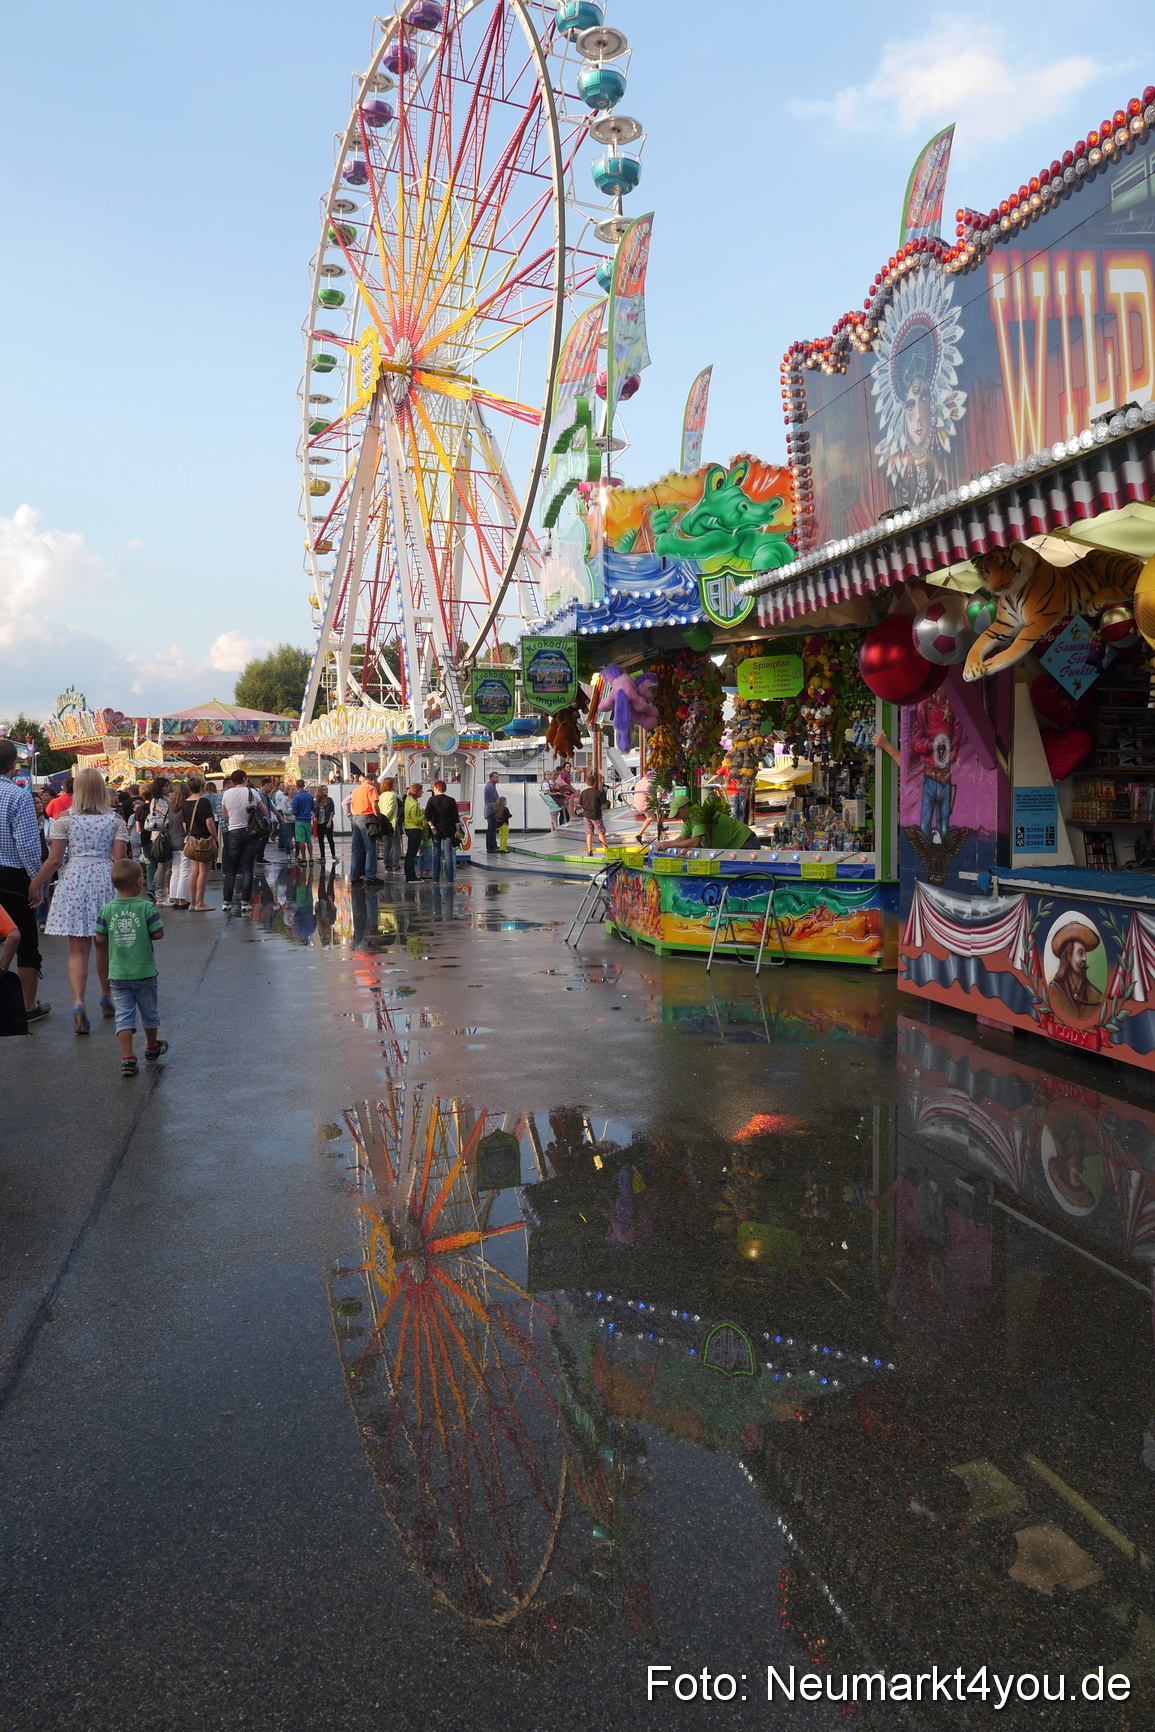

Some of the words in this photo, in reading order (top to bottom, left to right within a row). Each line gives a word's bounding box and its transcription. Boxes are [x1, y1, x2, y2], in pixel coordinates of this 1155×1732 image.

[911, 138, 951, 223] Crocodile
[618, 221, 651, 294] Crocodile
[563, 306, 603, 380] Crocodile
[985, 249, 1155, 463] WILD
[524, 639, 574, 655] Krokodile
[753, 660, 791, 670] Spielplan
[1067, 652, 1087, 665] Sie
[473, 670, 512, 684] Krokodile
[1059, 664, 1095, 678] Punkte
[535, 690, 566, 708] angeln
[480, 716, 506, 726] angeln
[1055, 1023, 1089, 1045] CODY
